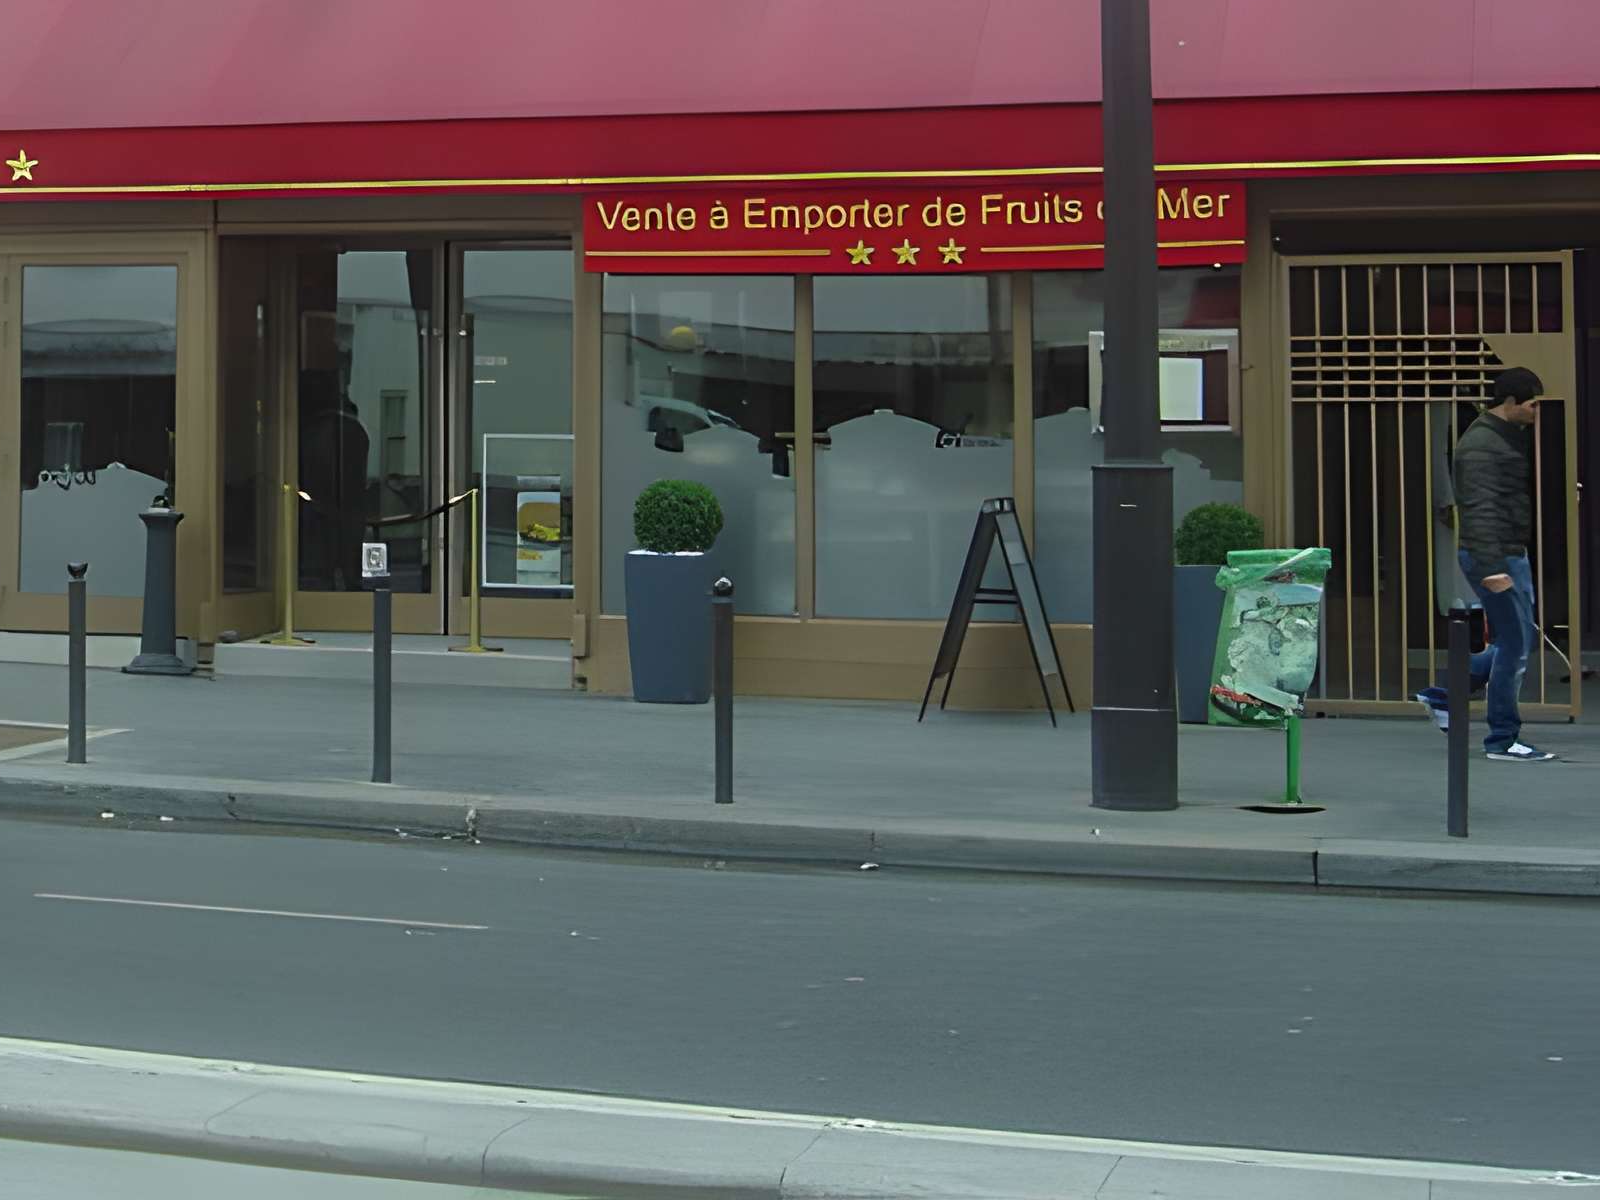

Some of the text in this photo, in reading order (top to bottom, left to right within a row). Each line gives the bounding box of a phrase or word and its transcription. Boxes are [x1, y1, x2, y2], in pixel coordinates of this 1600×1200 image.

[596, 200, 697, 231] Vente
[709, 200, 729, 230] à
[743, 197, 911, 235] Emporter
[921, 195, 967, 228] de
[981, 191, 1084, 225] Fruits
[1156, 187, 1231, 221] Mer
